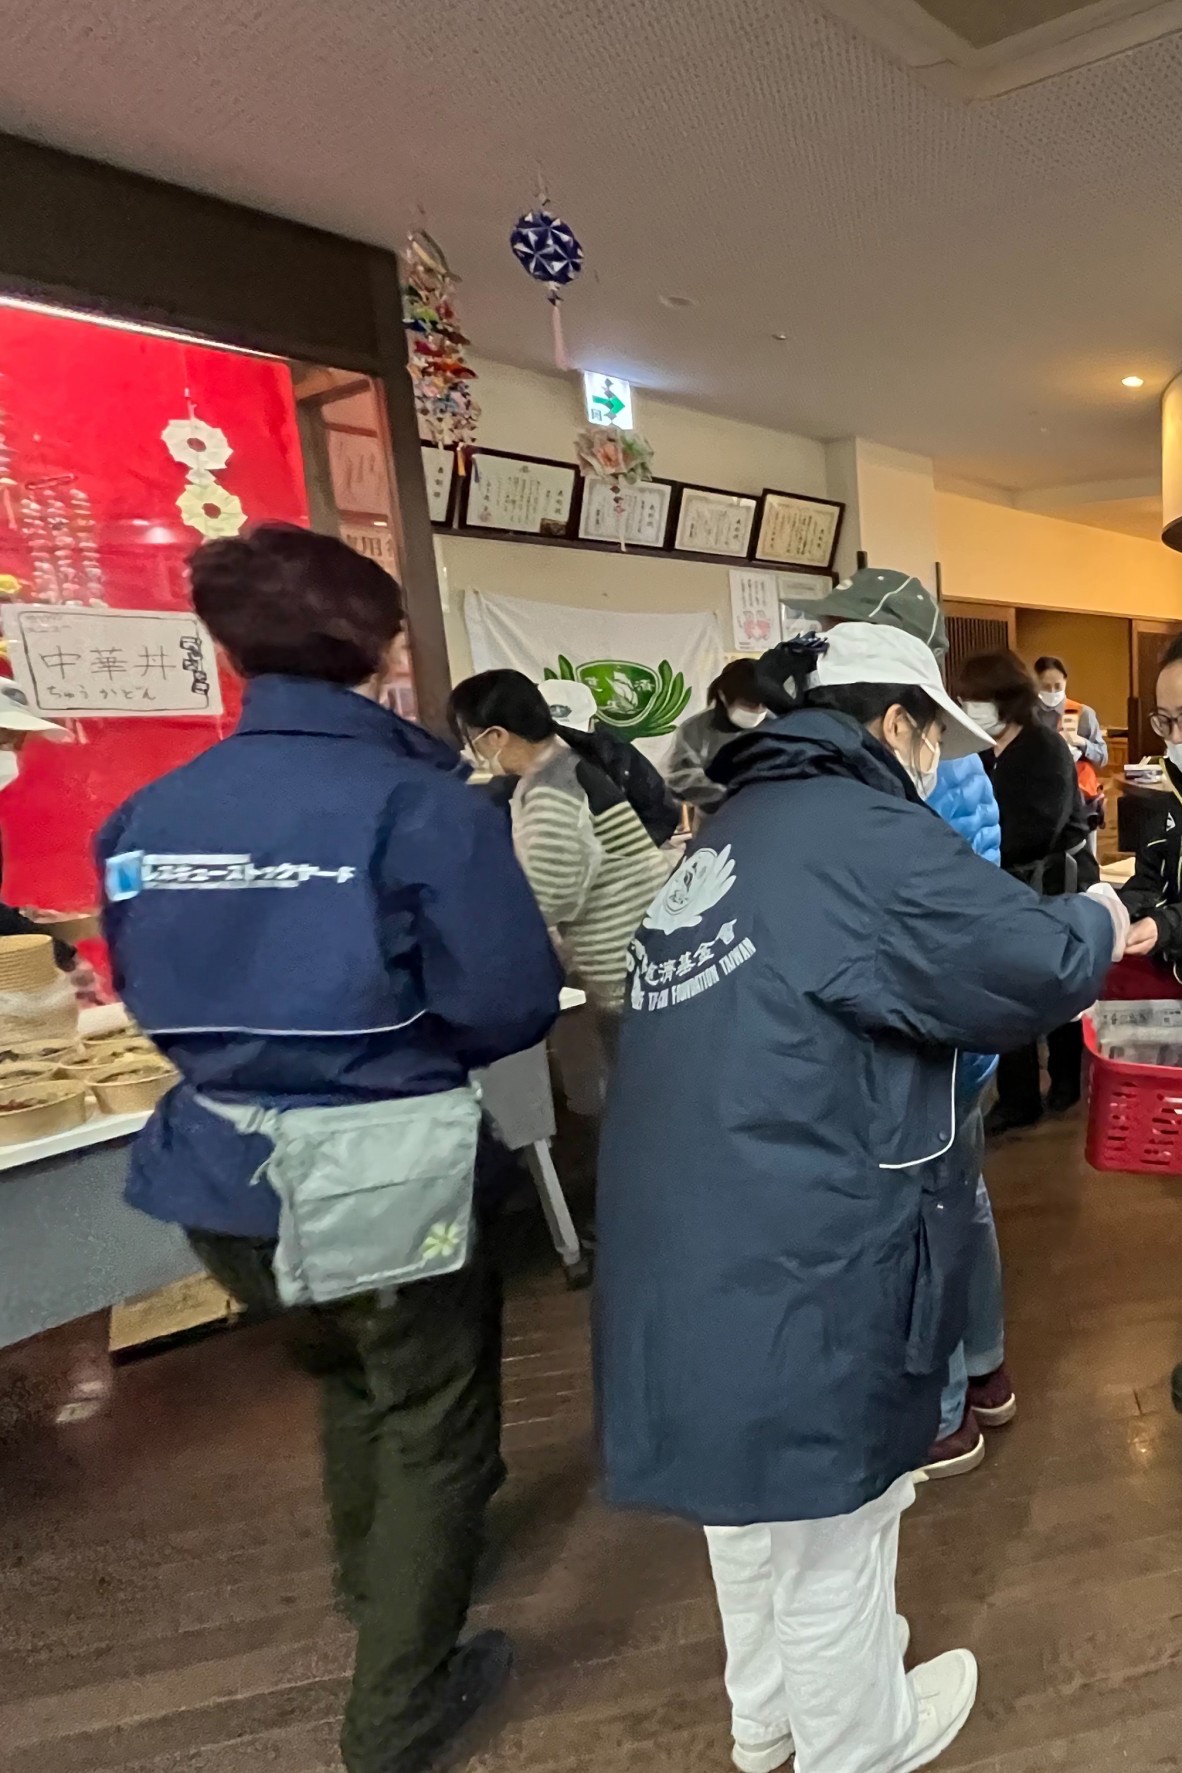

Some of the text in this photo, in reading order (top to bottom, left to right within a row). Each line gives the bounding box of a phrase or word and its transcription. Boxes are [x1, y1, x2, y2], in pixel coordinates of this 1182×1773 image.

[39, 645, 177, 680] 中華丼
[46, 684, 157, 701] ちゅうかどん
[718, 936, 757, 976] TAIWAN
